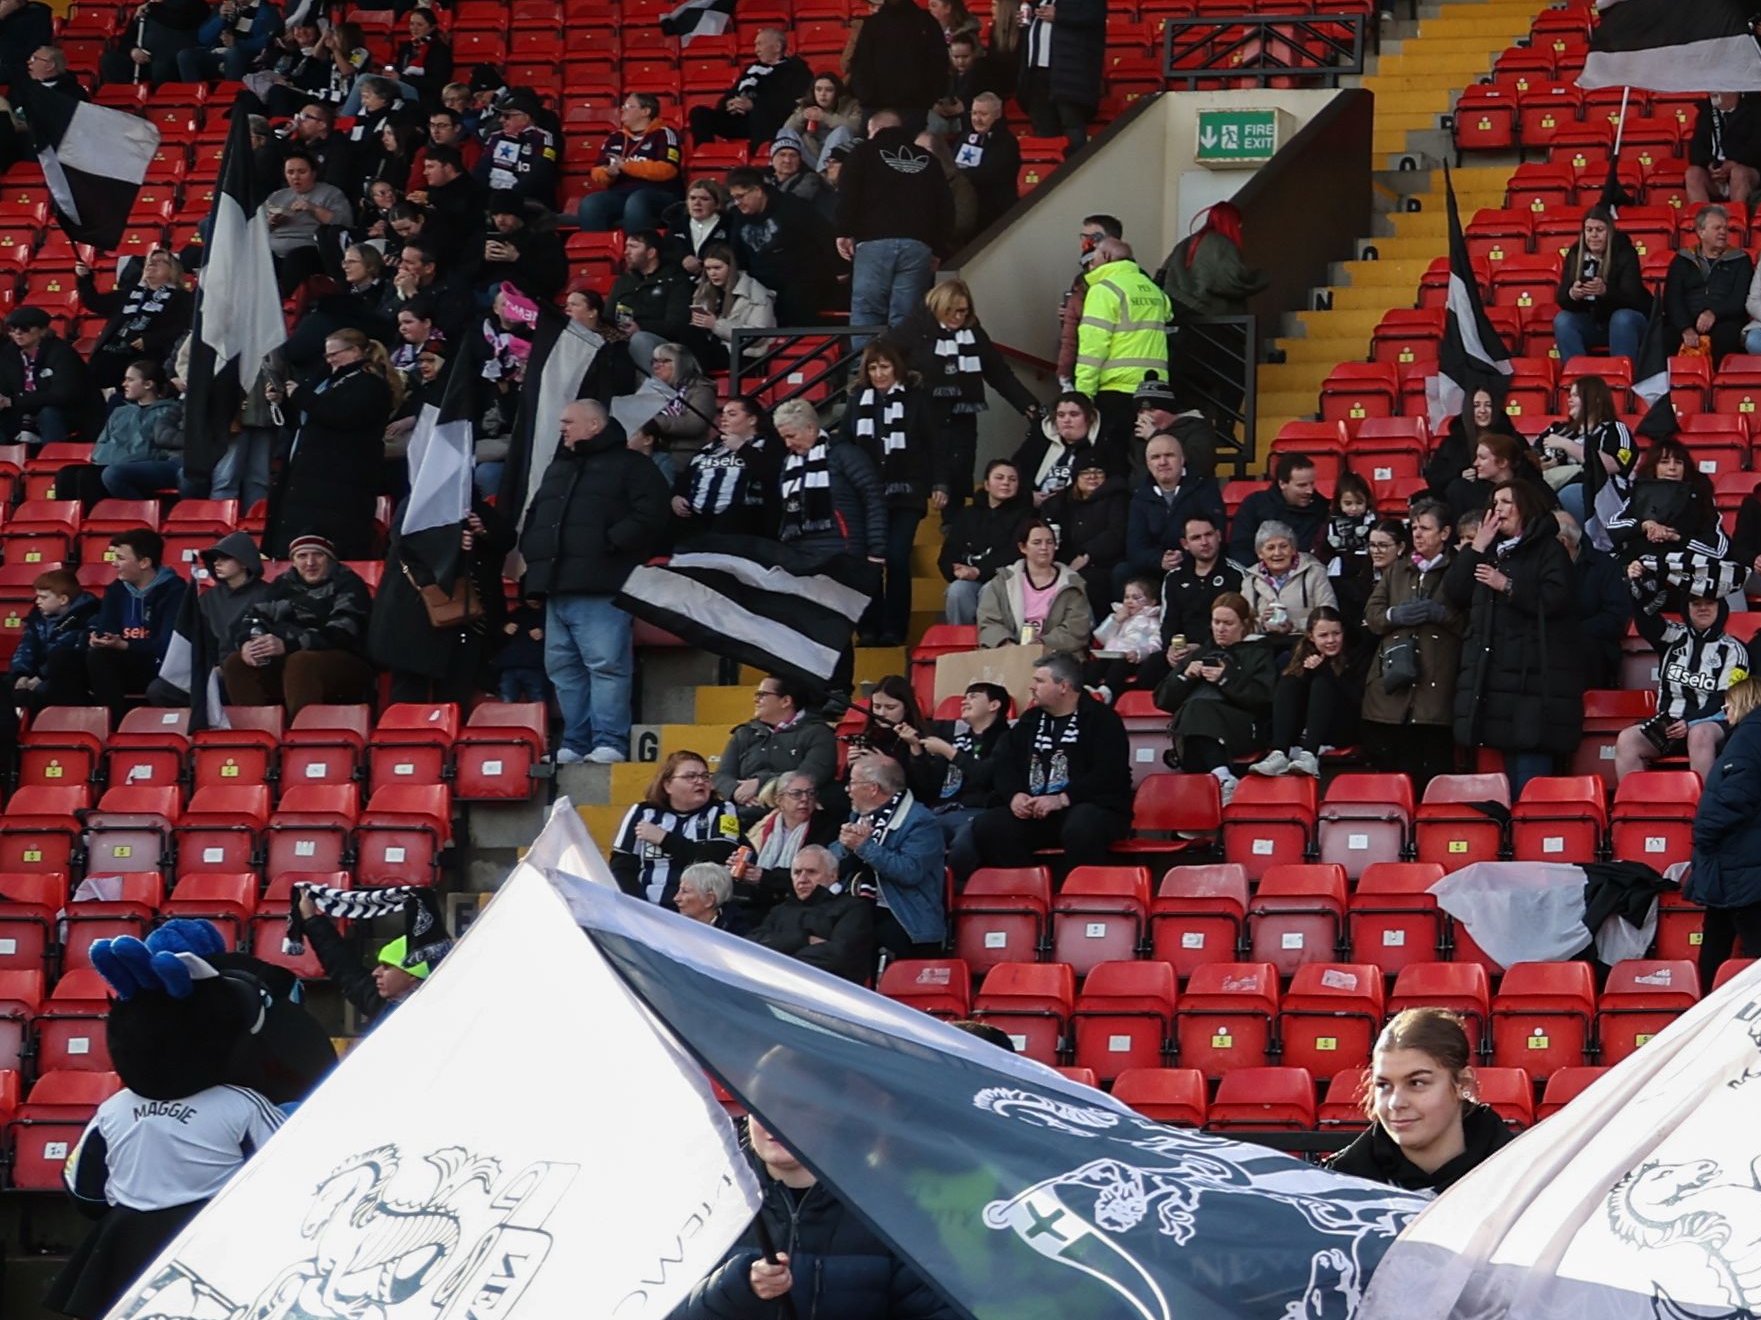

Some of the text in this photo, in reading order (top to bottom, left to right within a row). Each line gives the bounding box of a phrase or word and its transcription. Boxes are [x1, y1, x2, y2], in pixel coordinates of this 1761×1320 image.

[1244, 123, 1275, 136] FIRE
[1244, 137, 1273, 149] EXIT
[1681, 668, 1718, 691] sela
[640, 731, 659, 762] G
[133, 1099, 197, 1125] MAGGIE
